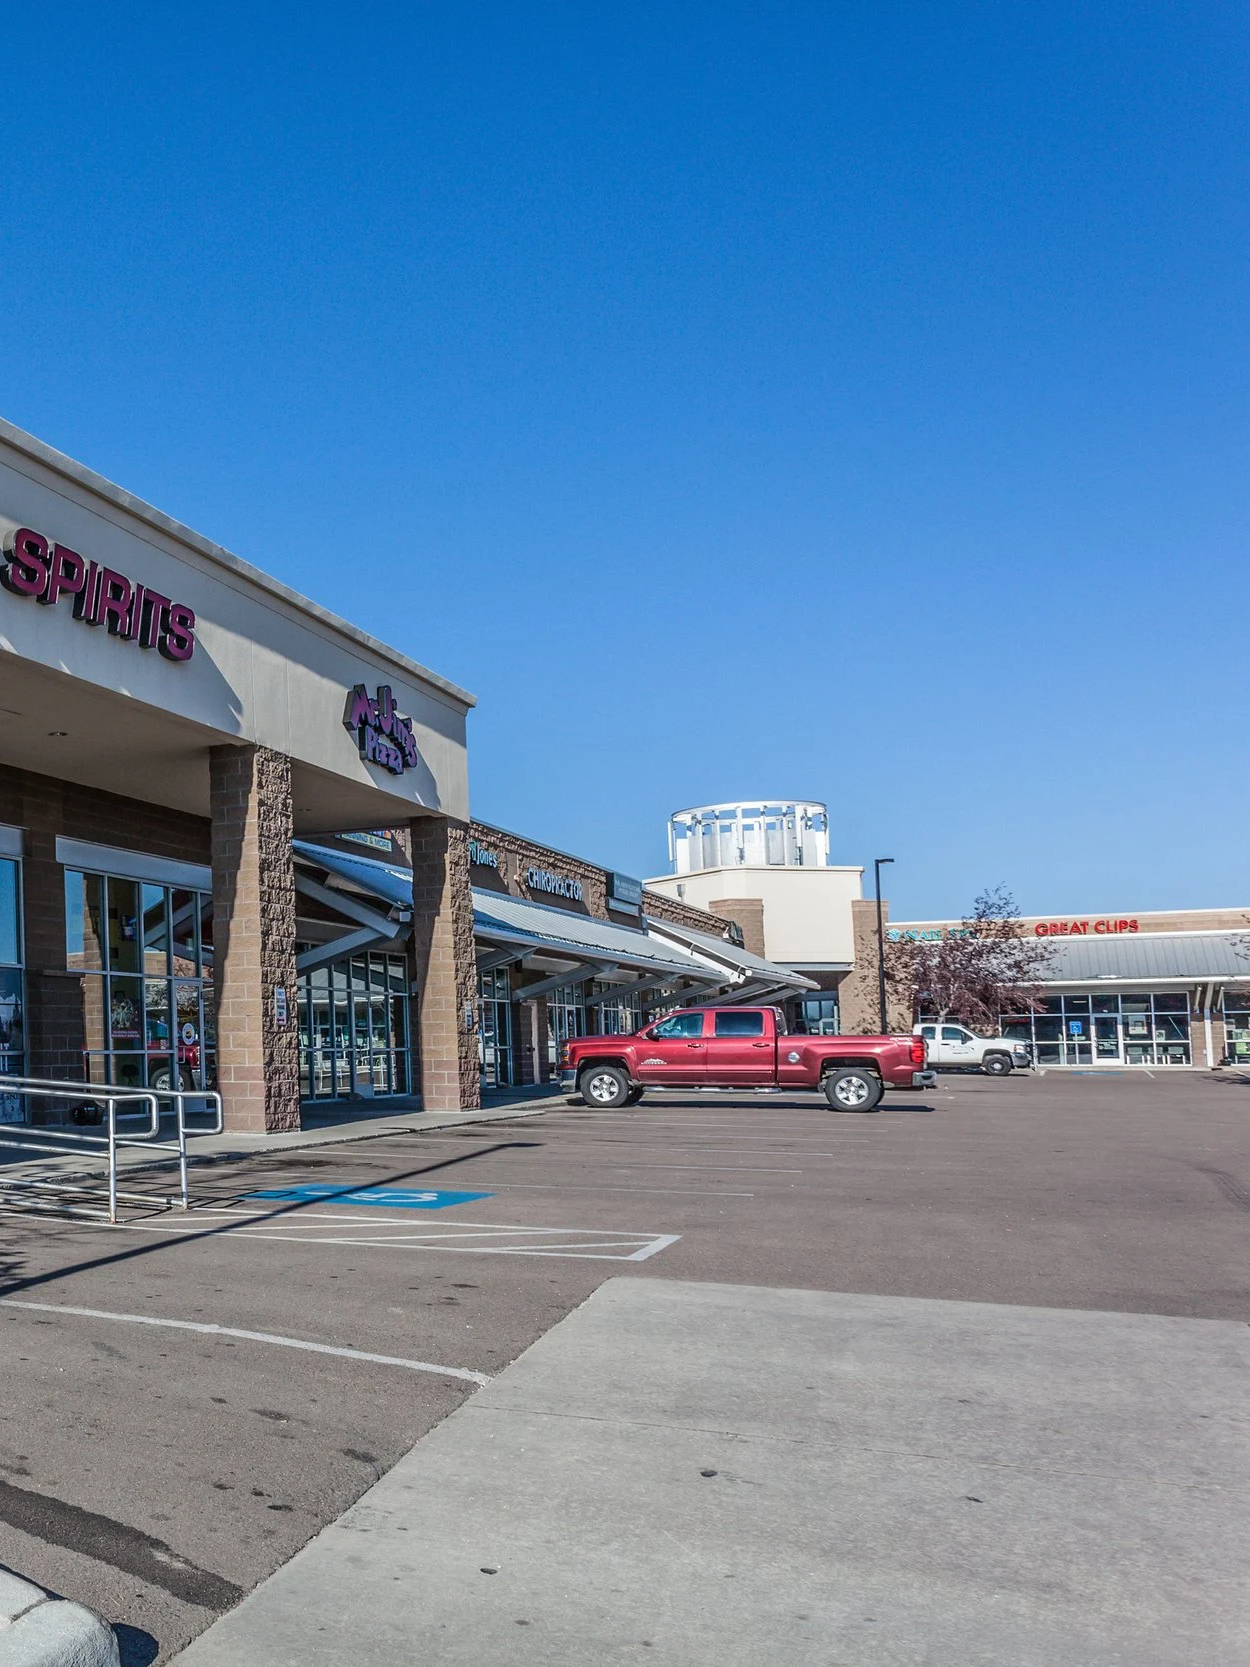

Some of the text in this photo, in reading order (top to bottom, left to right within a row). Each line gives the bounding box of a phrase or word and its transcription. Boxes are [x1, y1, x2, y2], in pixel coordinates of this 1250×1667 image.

[0, 528, 196, 662] SPIRITS
[476, 842, 499, 868] Jones
[527, 867, 583, 902] CHIROPRACTOR
[1035, 919, 1139, 937] GREAT CLIPS
